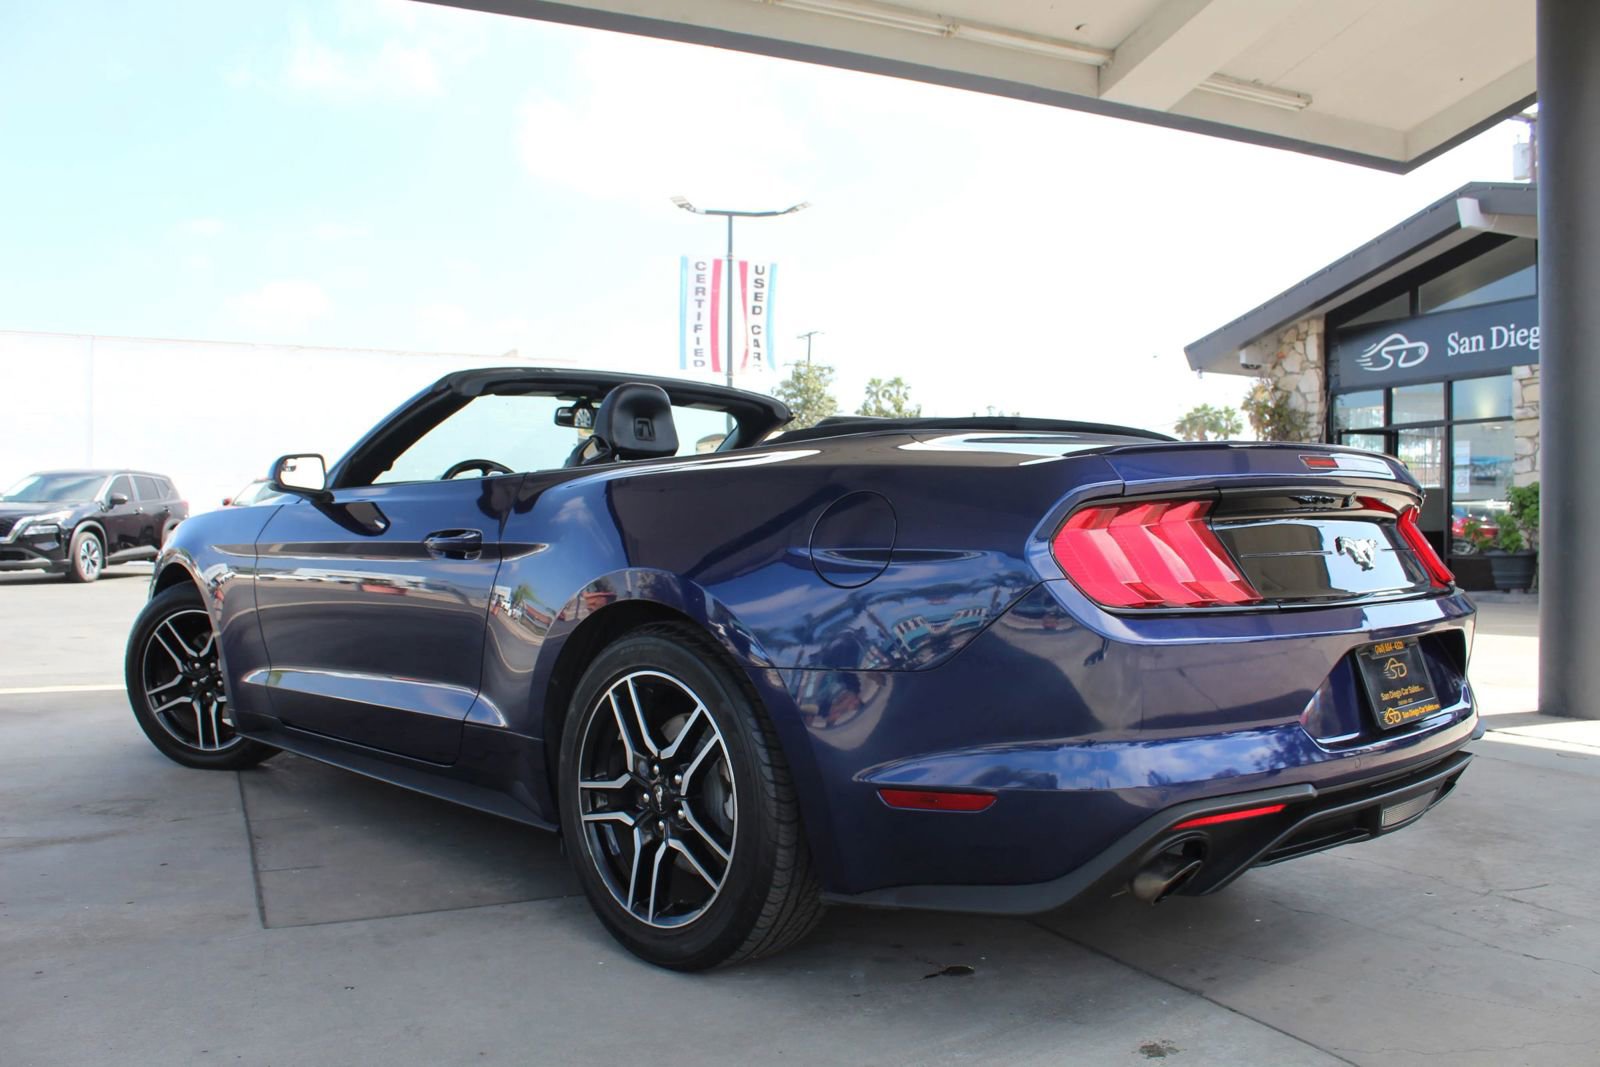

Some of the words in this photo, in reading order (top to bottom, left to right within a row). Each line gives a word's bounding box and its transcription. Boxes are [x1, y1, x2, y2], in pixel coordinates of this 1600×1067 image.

[693, 261, 706, 368] CERTIFIED
[752, 264, 765, 316] USED
[751, 324, 762, 372] CAR
[1447, 330, 1485, 356] San
[1490, 323, 1541, 350] Dieg
